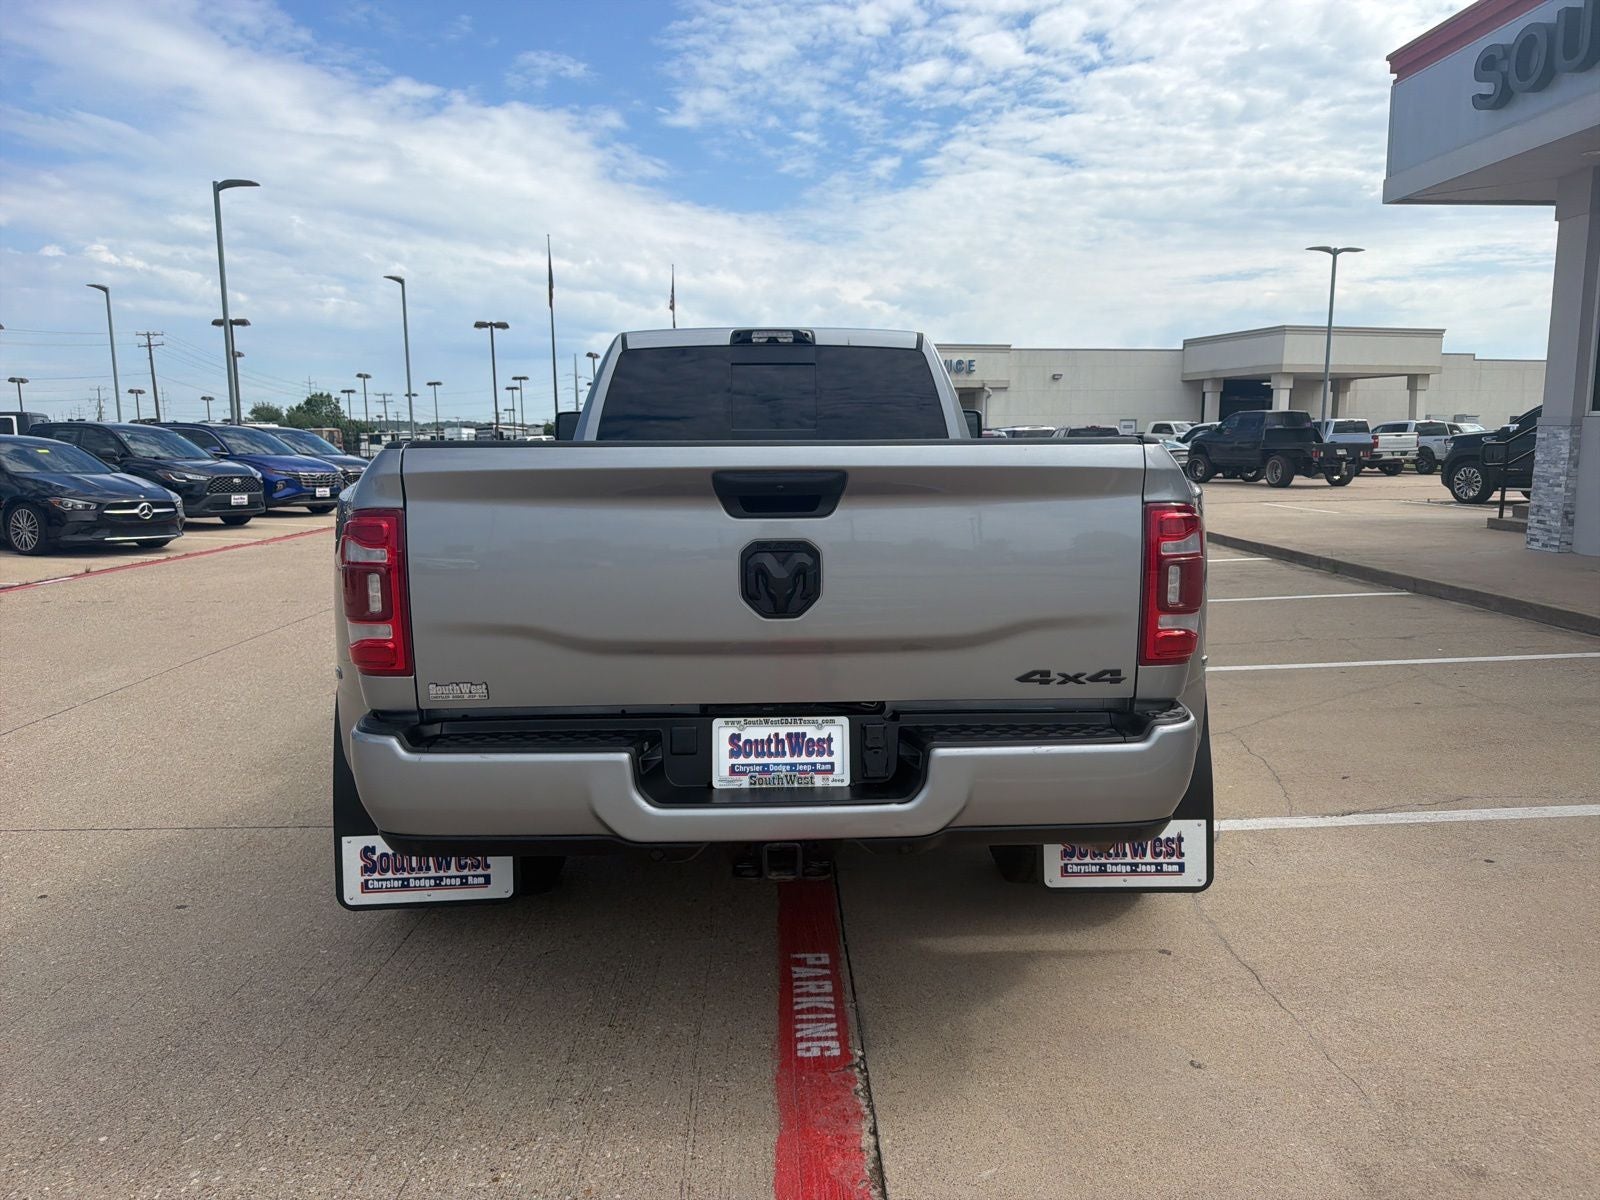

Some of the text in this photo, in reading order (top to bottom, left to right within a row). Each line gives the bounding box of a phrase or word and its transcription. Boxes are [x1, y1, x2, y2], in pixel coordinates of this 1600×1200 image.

[1472, 0, 1600, 110] SOU
[944, 359, 976, 372] ICE
[1014, 669, 1127, 685] 4x4
[724, 718, 836, 726] www.SouthWestCDJRTexas.com
[728, 732, 834, 759] SouthWest
[734, 764, 763, 773] Chrysler
[769, 763, 791, 772] Dodge
[796, 763, 812, 772] Jeep
[749, 773, 815, 786] SouthWest
[1067, 863, 1179, 873] Chrysler Dodge Jeep Ram
[368, 876, 485, 889] Chrysler Dodge Jeep Ram
[790, 953, 841, 1057] PARKING
